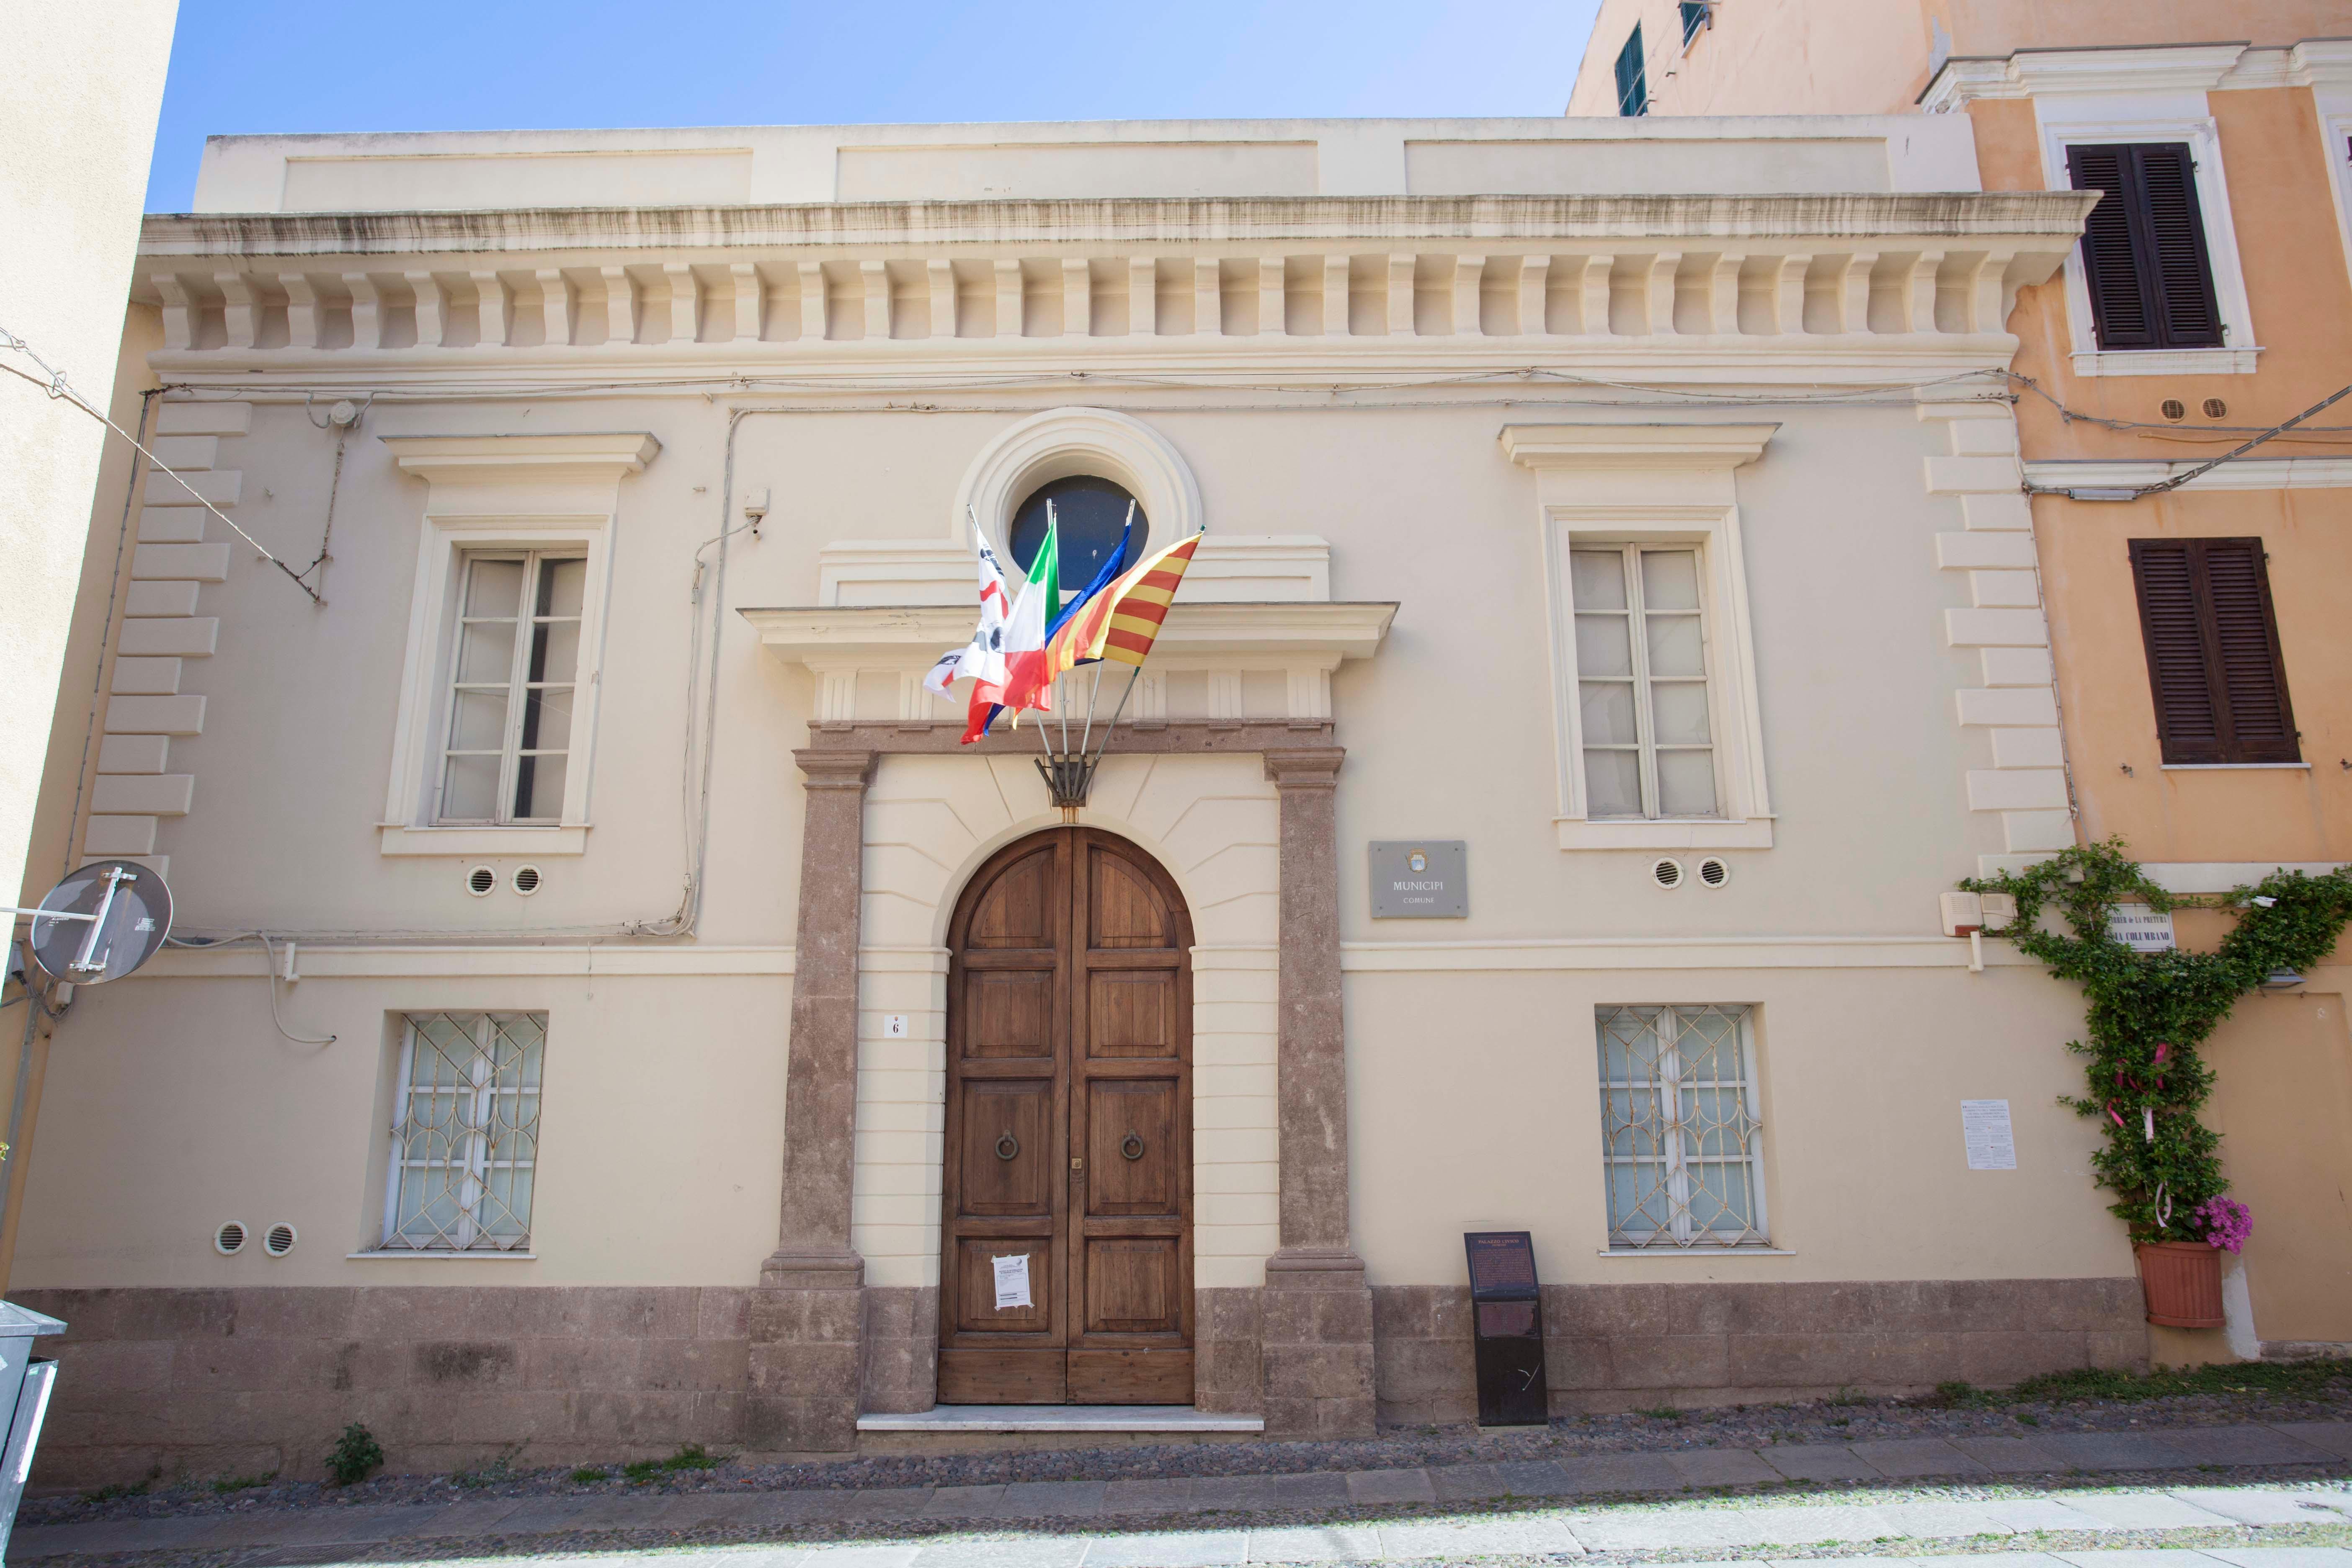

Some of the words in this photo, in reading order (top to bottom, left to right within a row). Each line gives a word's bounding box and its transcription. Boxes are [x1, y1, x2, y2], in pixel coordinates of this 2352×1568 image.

[1393, 881, 1443, 891] MUNICIPI
[2114, 932, 2123, 941] IA
[2125, 932, 2169, 941] COLUMBANO
[893, 1023, 899, 1034] 6
